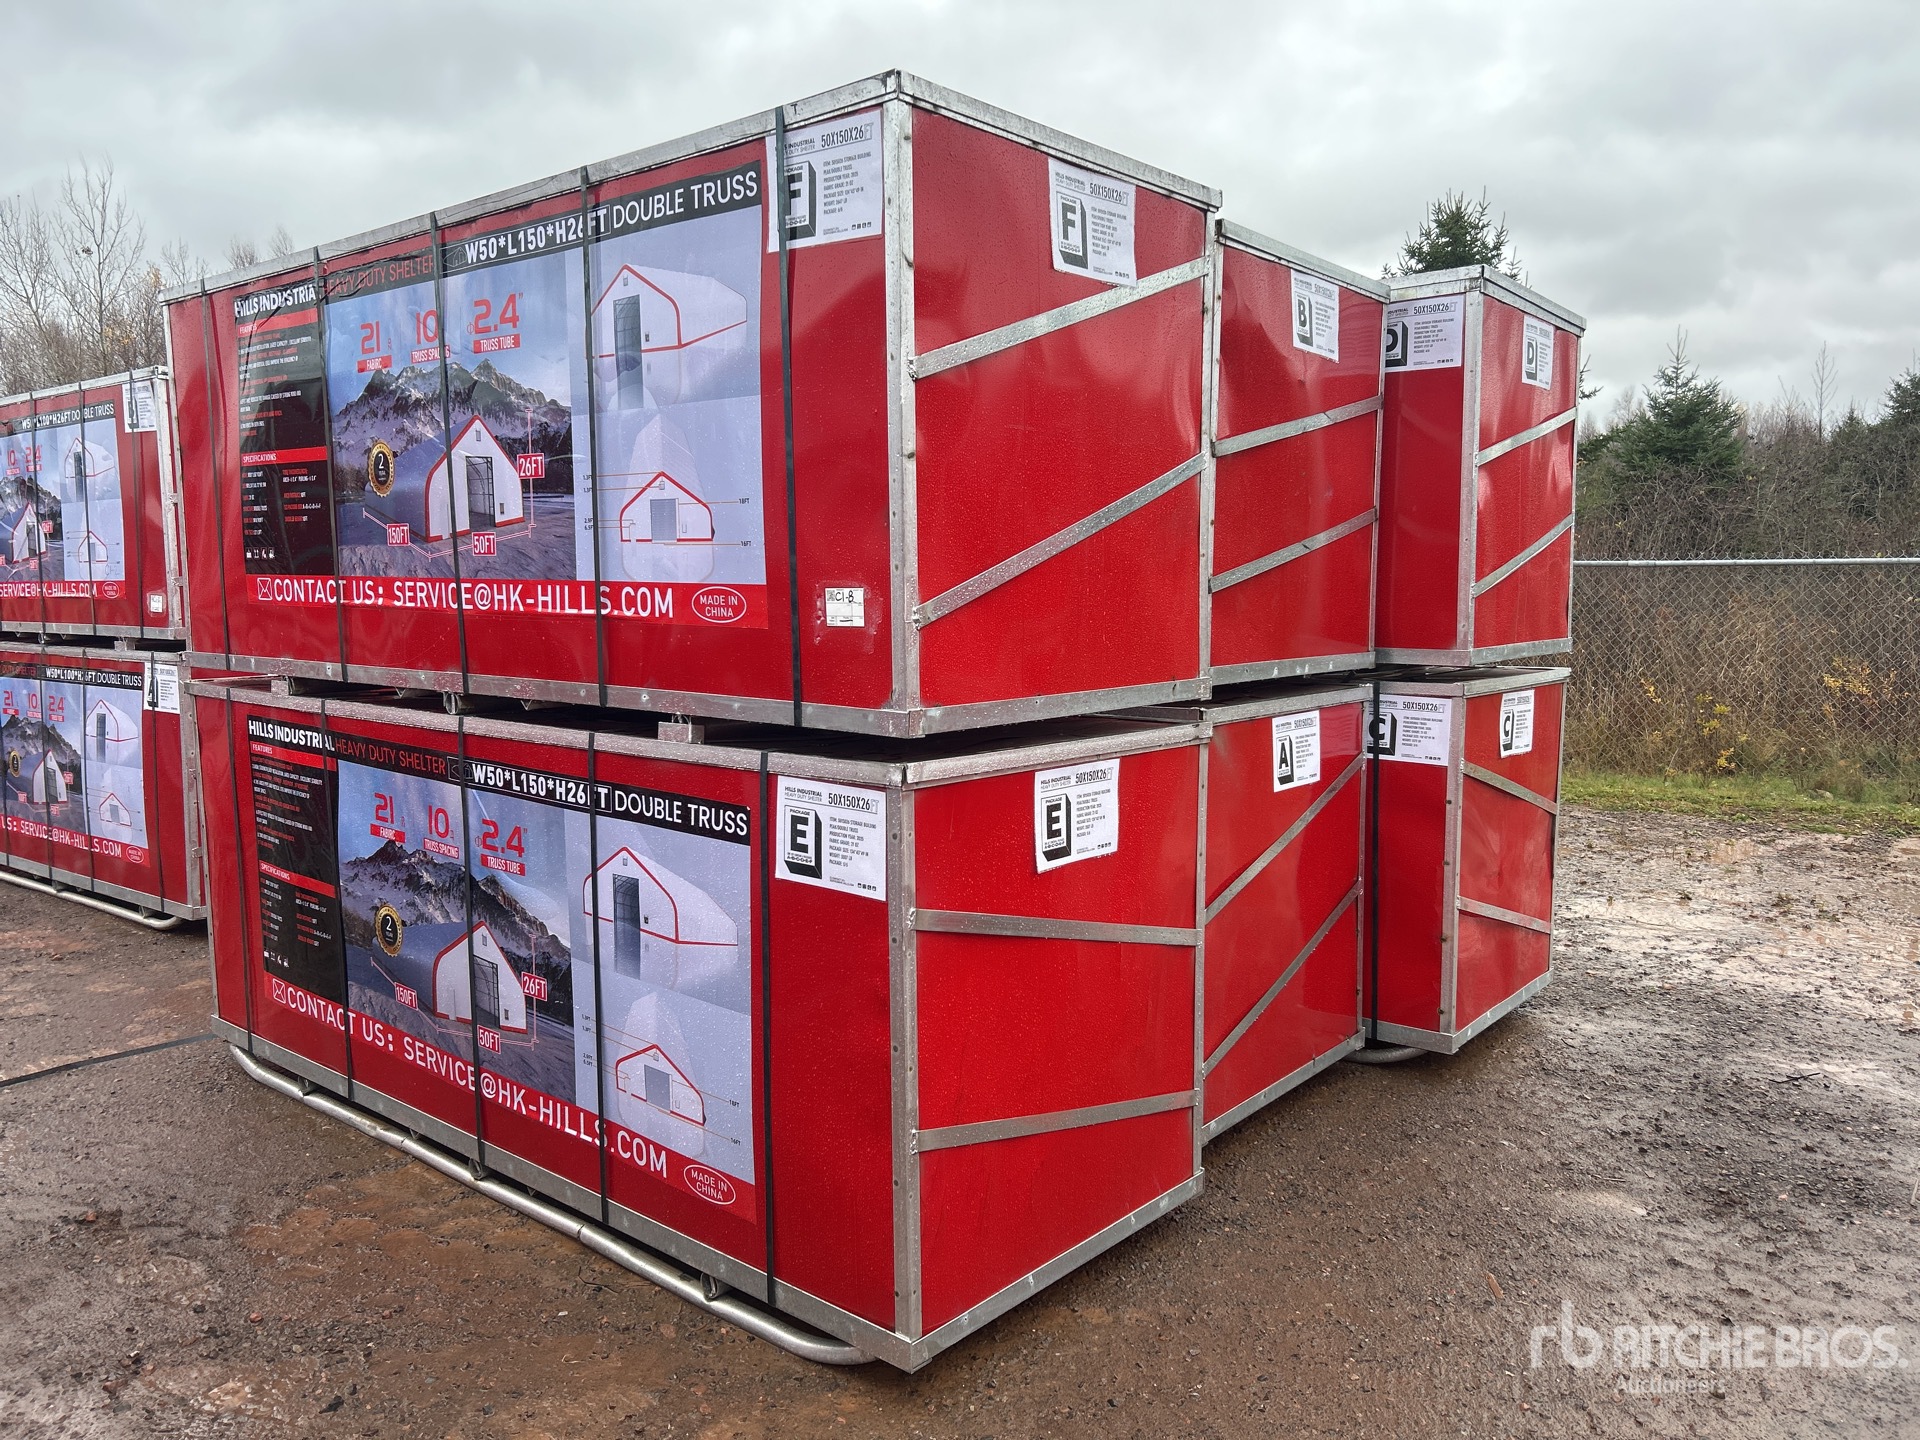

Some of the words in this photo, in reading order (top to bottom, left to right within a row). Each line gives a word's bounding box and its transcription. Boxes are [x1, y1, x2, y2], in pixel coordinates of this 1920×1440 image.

[613, 188, 684, 230] DOUBLE
[690, 170, 758, 209] TRUSS
[1062, 202, 1076, 241] F
[358, 266, 387, 288] DUTY
[1297, 299, 1307, 328] B
[360, 321, 380, 354] 21
[416, 310, 438, 345] 10
[480, 338, 499, 352] TRUSS
[500, 336, 515, 349] TUBE
[1526, 342, 1534, 365] D
[71, 408, 94, 420] DOBLE
[95, 403, 114, 416] TRUSS
[378, 453, 384, 469] 2
[519, 456, 543, 476] 26FT
[388, 526, 409, 544] 150FT
[474, 535, 494, 554] 50FT
[274, 578, 346, 604] CONTACT
[352, 579, 384, 605] US:
[393, 581, 674, 618] SERVICE@HK-HILLS.COM
[699, 595, 725, 606] MADE
[728, 596, 738, 606] IN
[705, 606, 734, 618] CHINA
[97, 673, 121, 685] DOUBLE
[122, 675, 142, 687] TRUSS
[1368, 717, 1386, 740] C
[1504, 715, 1510, 738] C
[1279, 742, 1289, 769] A
[248, 720, 273, 739] HILLS
[336, 738, 367, 758] HEAVY
[369, 747, 395, 765] DUTY
[400, 751, 446, 775] SHELTER
[615, 790, 682, 824] DOUBLE
[687, 803, 748, 836] TRUSS
[374, 792, 394, 825] 21
[428, 805, 450, 838] 10
[1046, 803, 1061, 840] E
[790, 815, 808, 854] E
[424, 838, 439, 852] TRUSS
[439, 842, 459, 859] SPACING
[487, 856, 507, 873] TRUSS
[507, 861, 521, 874] TUBE
[386, 916, 392, 931] 2
[396, 985, 416, 1008] 150FT
[523, 976, 546, 999] 26FT
[478, 1028, 499, 1051] 50FT
[287, 987, 356, 1034] CONTACT
[362, 1018, 393, 1051] US:
[404, 1037, 667, 1179] SERVICE@HK-HILLS.COM
[691, 1170, 716, 1187] MADE
[718, 1180, 728, 1192] IN
[696, 1183, 724, 1201] CHINA
